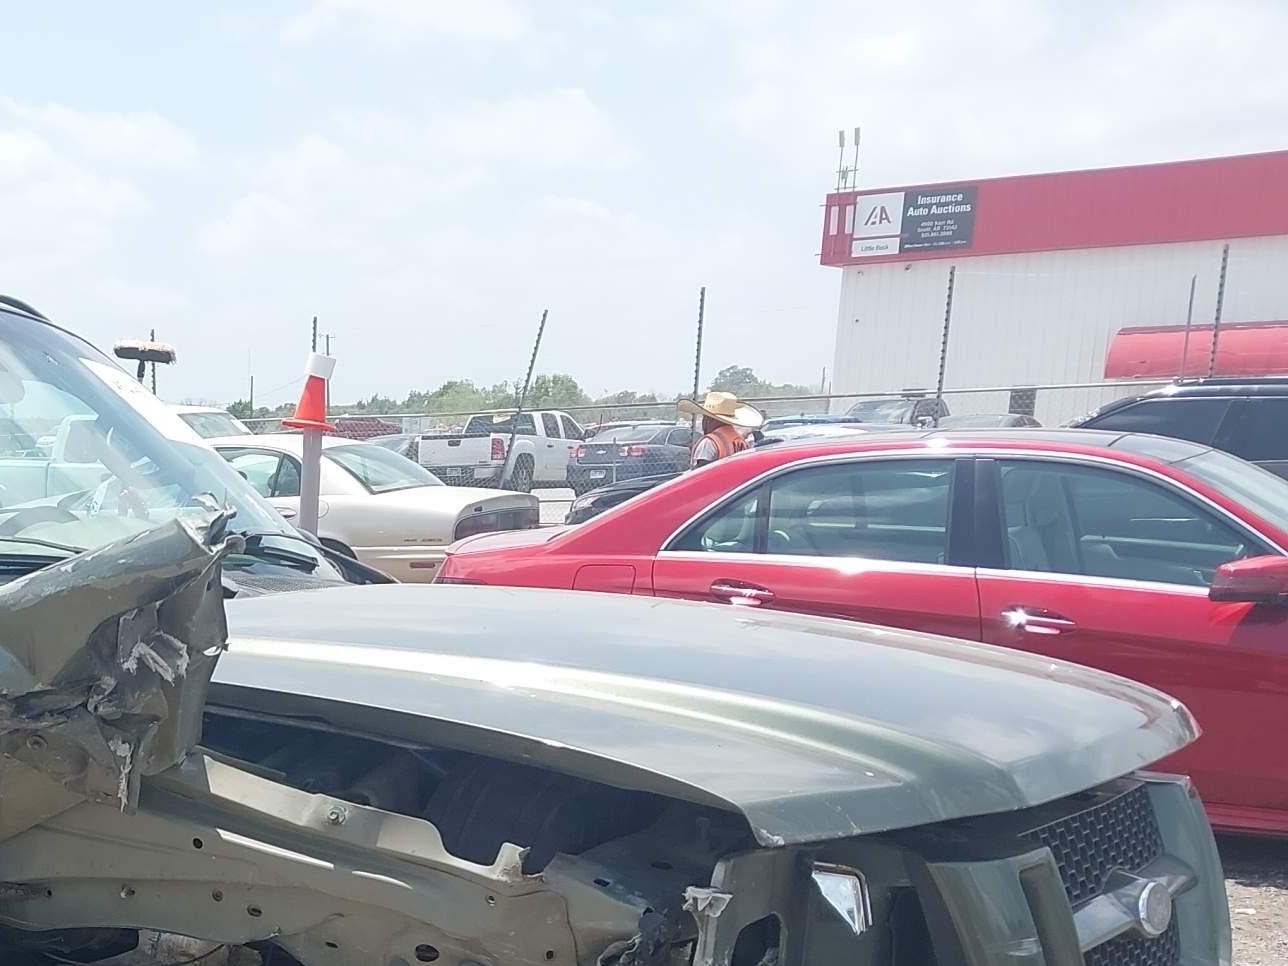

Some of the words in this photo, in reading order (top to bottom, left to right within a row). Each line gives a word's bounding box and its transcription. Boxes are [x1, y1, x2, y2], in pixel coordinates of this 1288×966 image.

[917, 193, 963, 205] Insurance
[907, 206, 928, 217] Auto
[930, 203, 971, 214] Auctions
